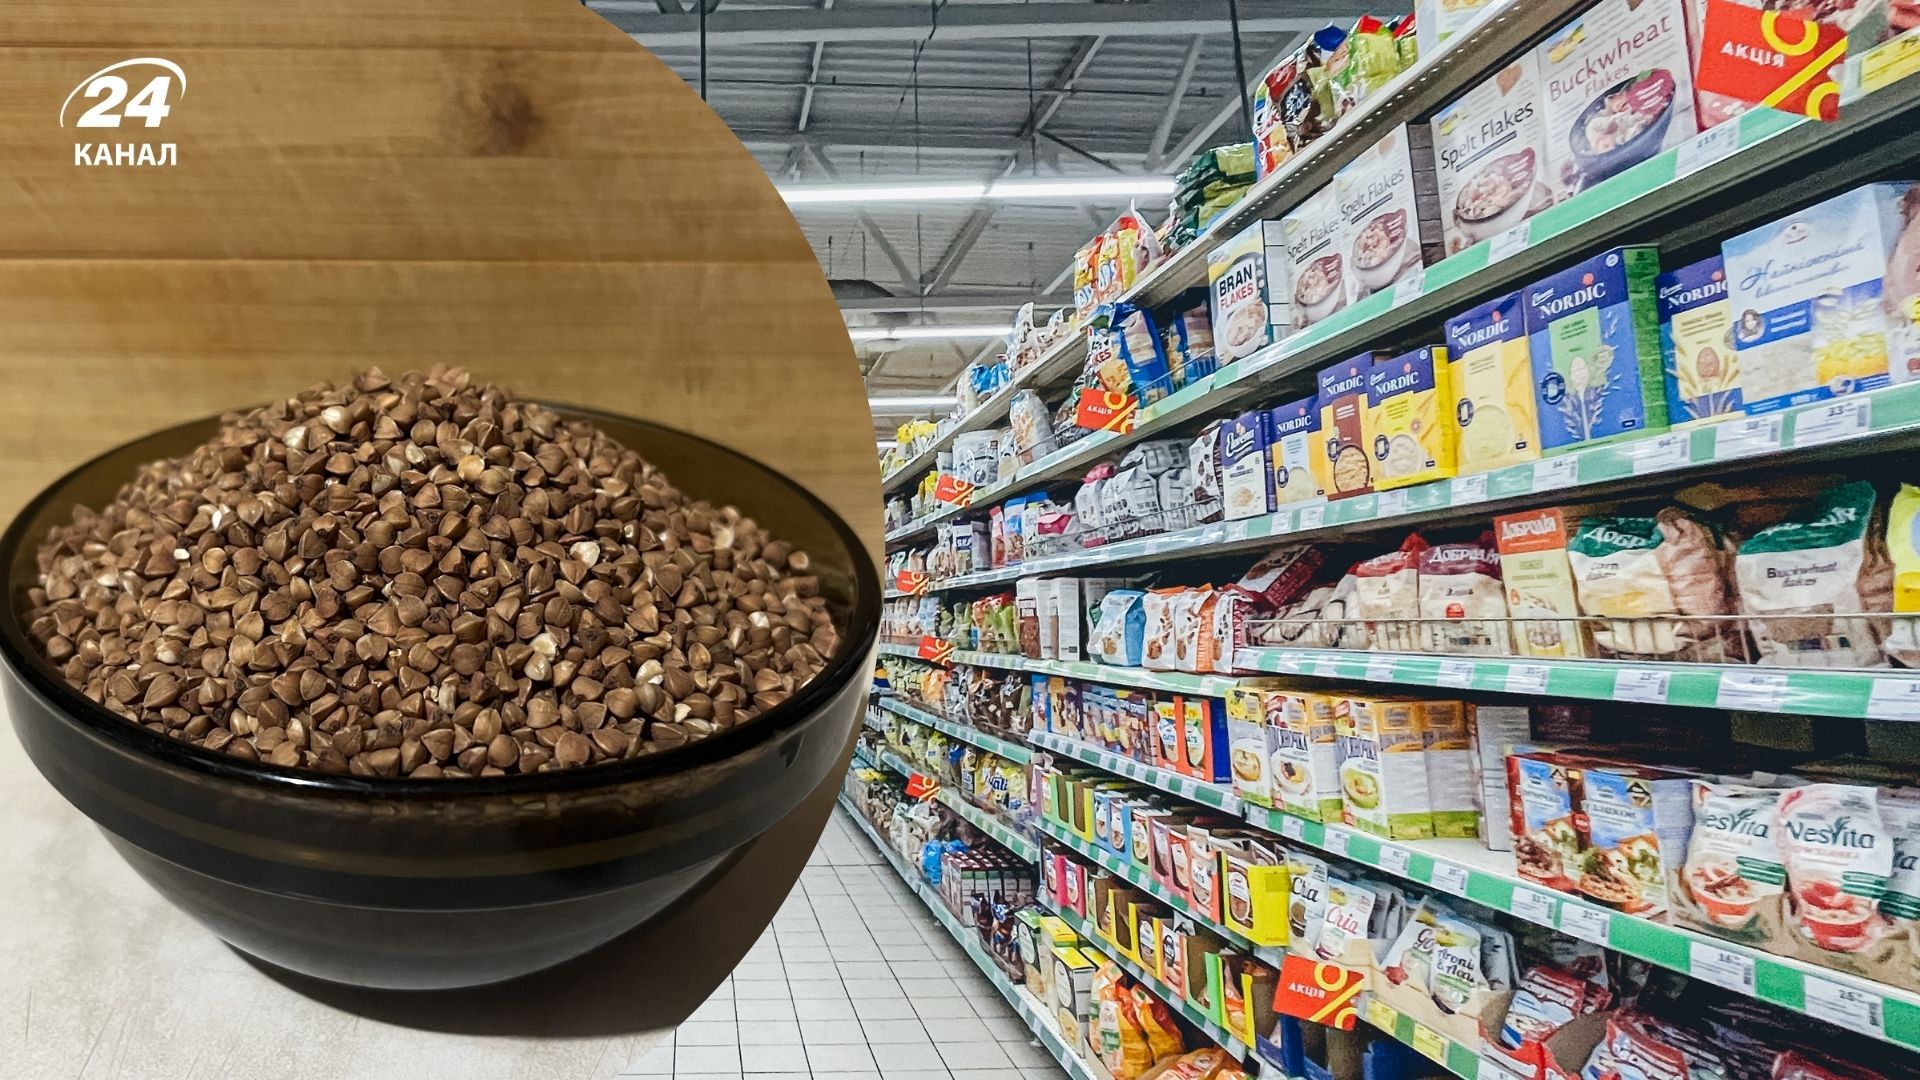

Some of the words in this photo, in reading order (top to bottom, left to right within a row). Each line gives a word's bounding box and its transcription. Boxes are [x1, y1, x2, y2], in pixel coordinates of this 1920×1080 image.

[1550, 14, 1672, 101] Buckwheat
[1721, 41, 1785, 67] АКЦІЯ
[1585, 64, 1630, 98] Flakes
[1441, 135, 1477, 170] Spelt
[1481, 102, 1534, 143] Flakes
[1341, 192, 1366, 221] Spelt
[1368, 169, 1405, 204] Flakes
[1219, 264, 1253, 298] BRAN
[1220, 282, 1254, 309] FLAKES
[1540, 283, 1606, 319] NORDIC
[1458, 319, 1510, 350] NORDIC
[1326, 375, 1364, 398] NORDIC
[1375, 371, 1419, 397] NORDIC
[1276, 415, 1312, 435] NORDIC
[1786, 816, 1875, 849] NesVita
[1288, 982, 1326, 999] АКЦІЯ
